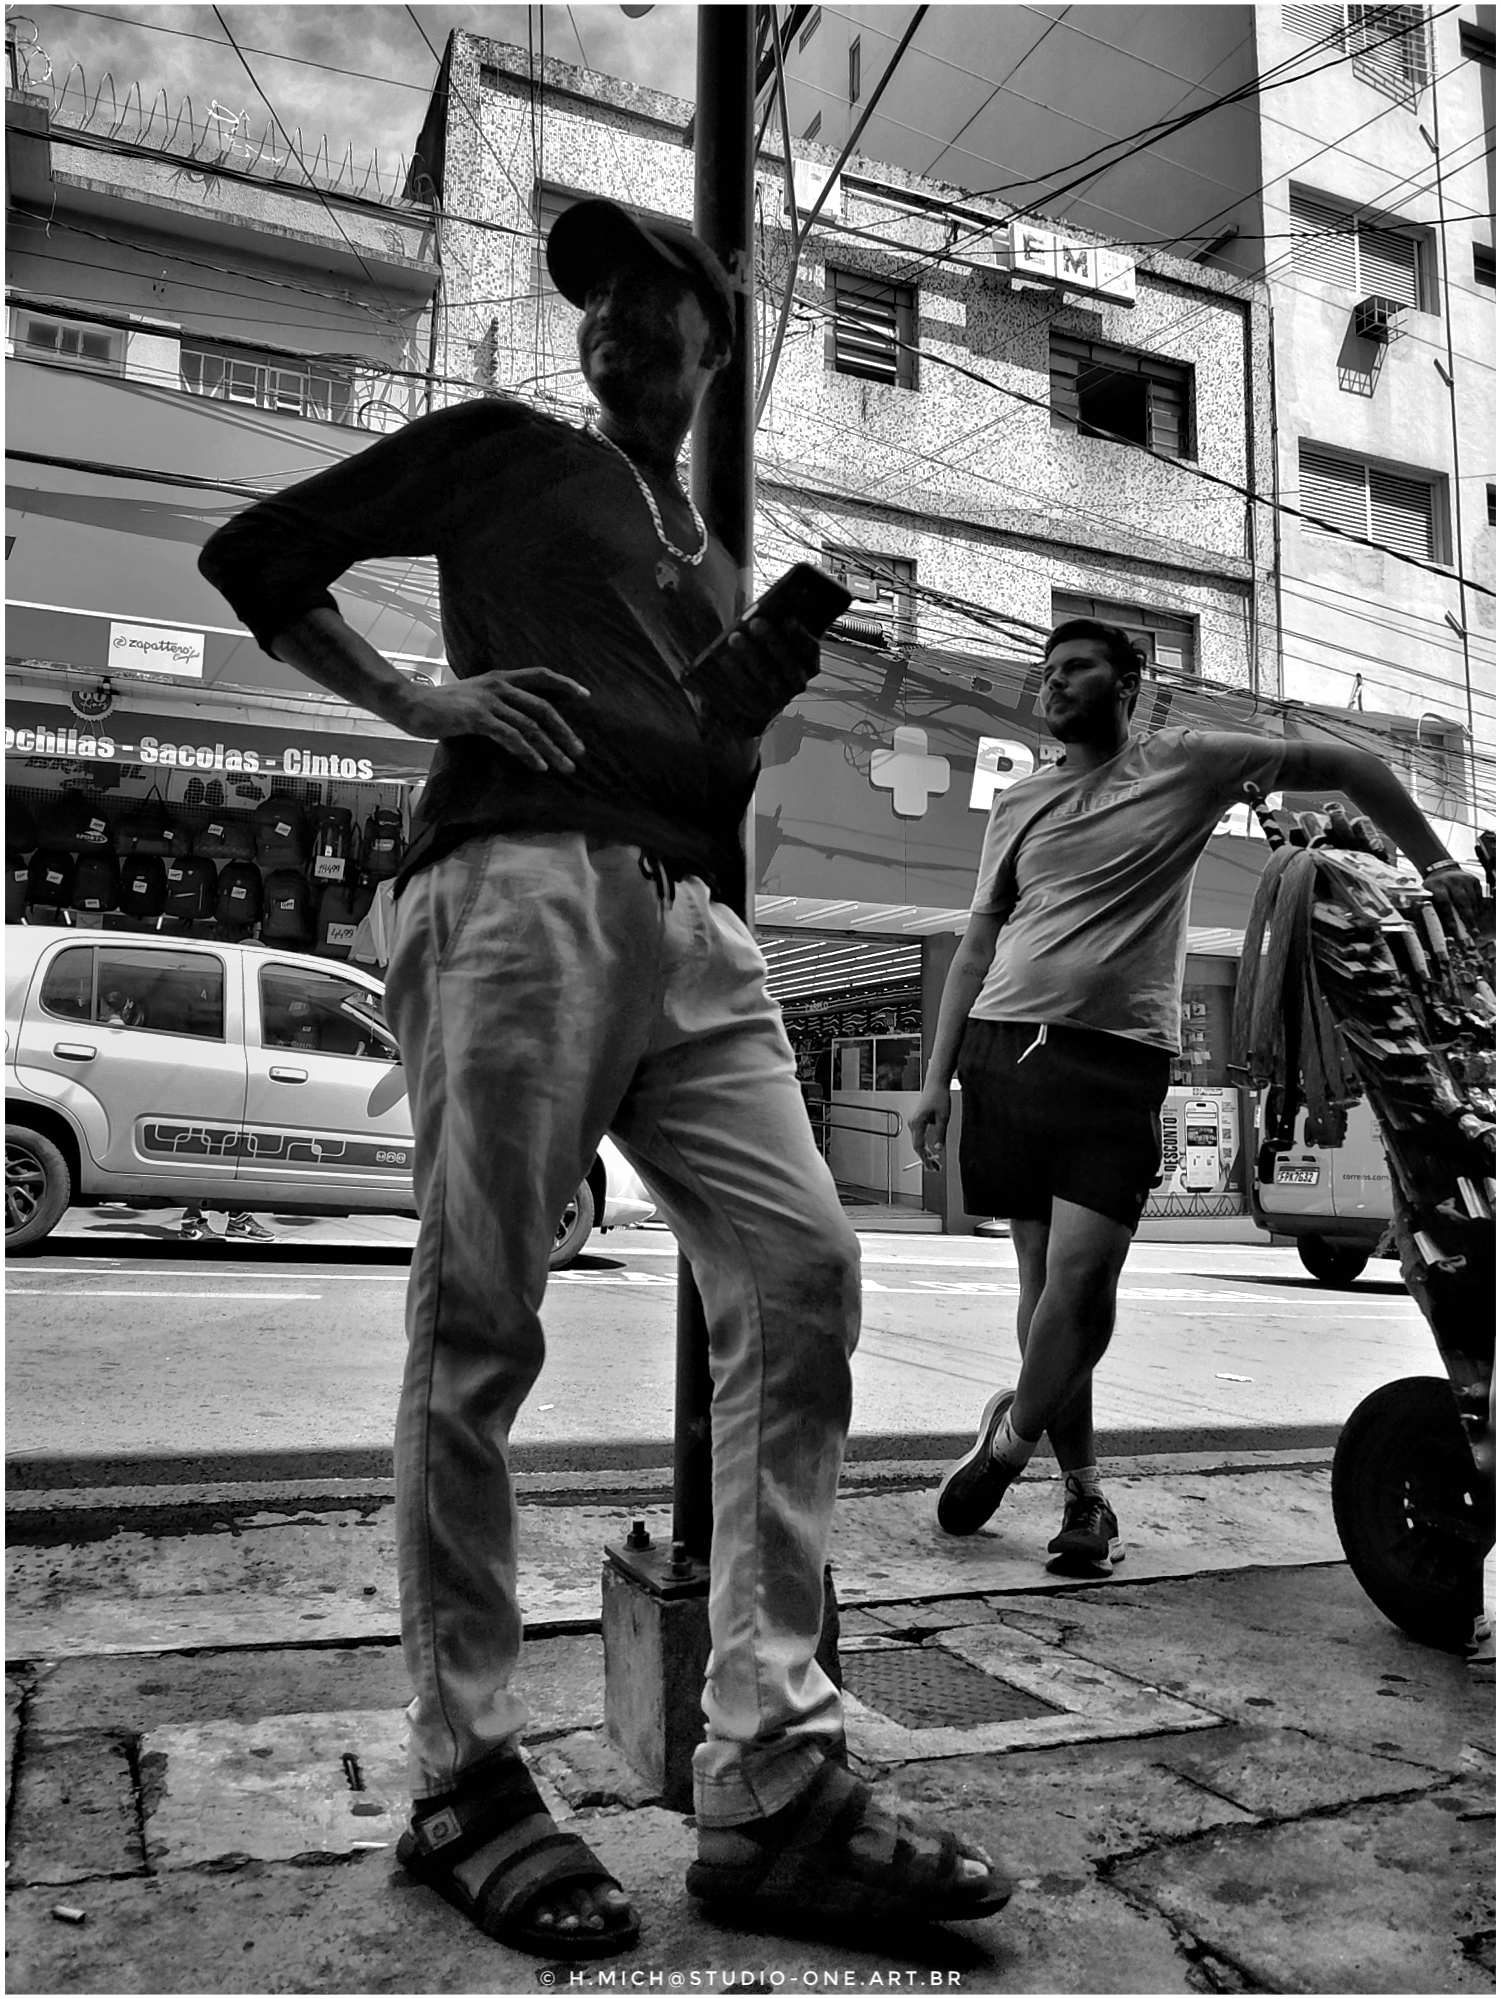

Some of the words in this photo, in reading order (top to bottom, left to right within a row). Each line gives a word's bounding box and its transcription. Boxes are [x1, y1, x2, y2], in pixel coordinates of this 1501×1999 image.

[140, 737, 259, 773] Sacolas
[283, 748, 374, 780] Cintos
[1162, 1117, 1179, 1173] DESCONTO
